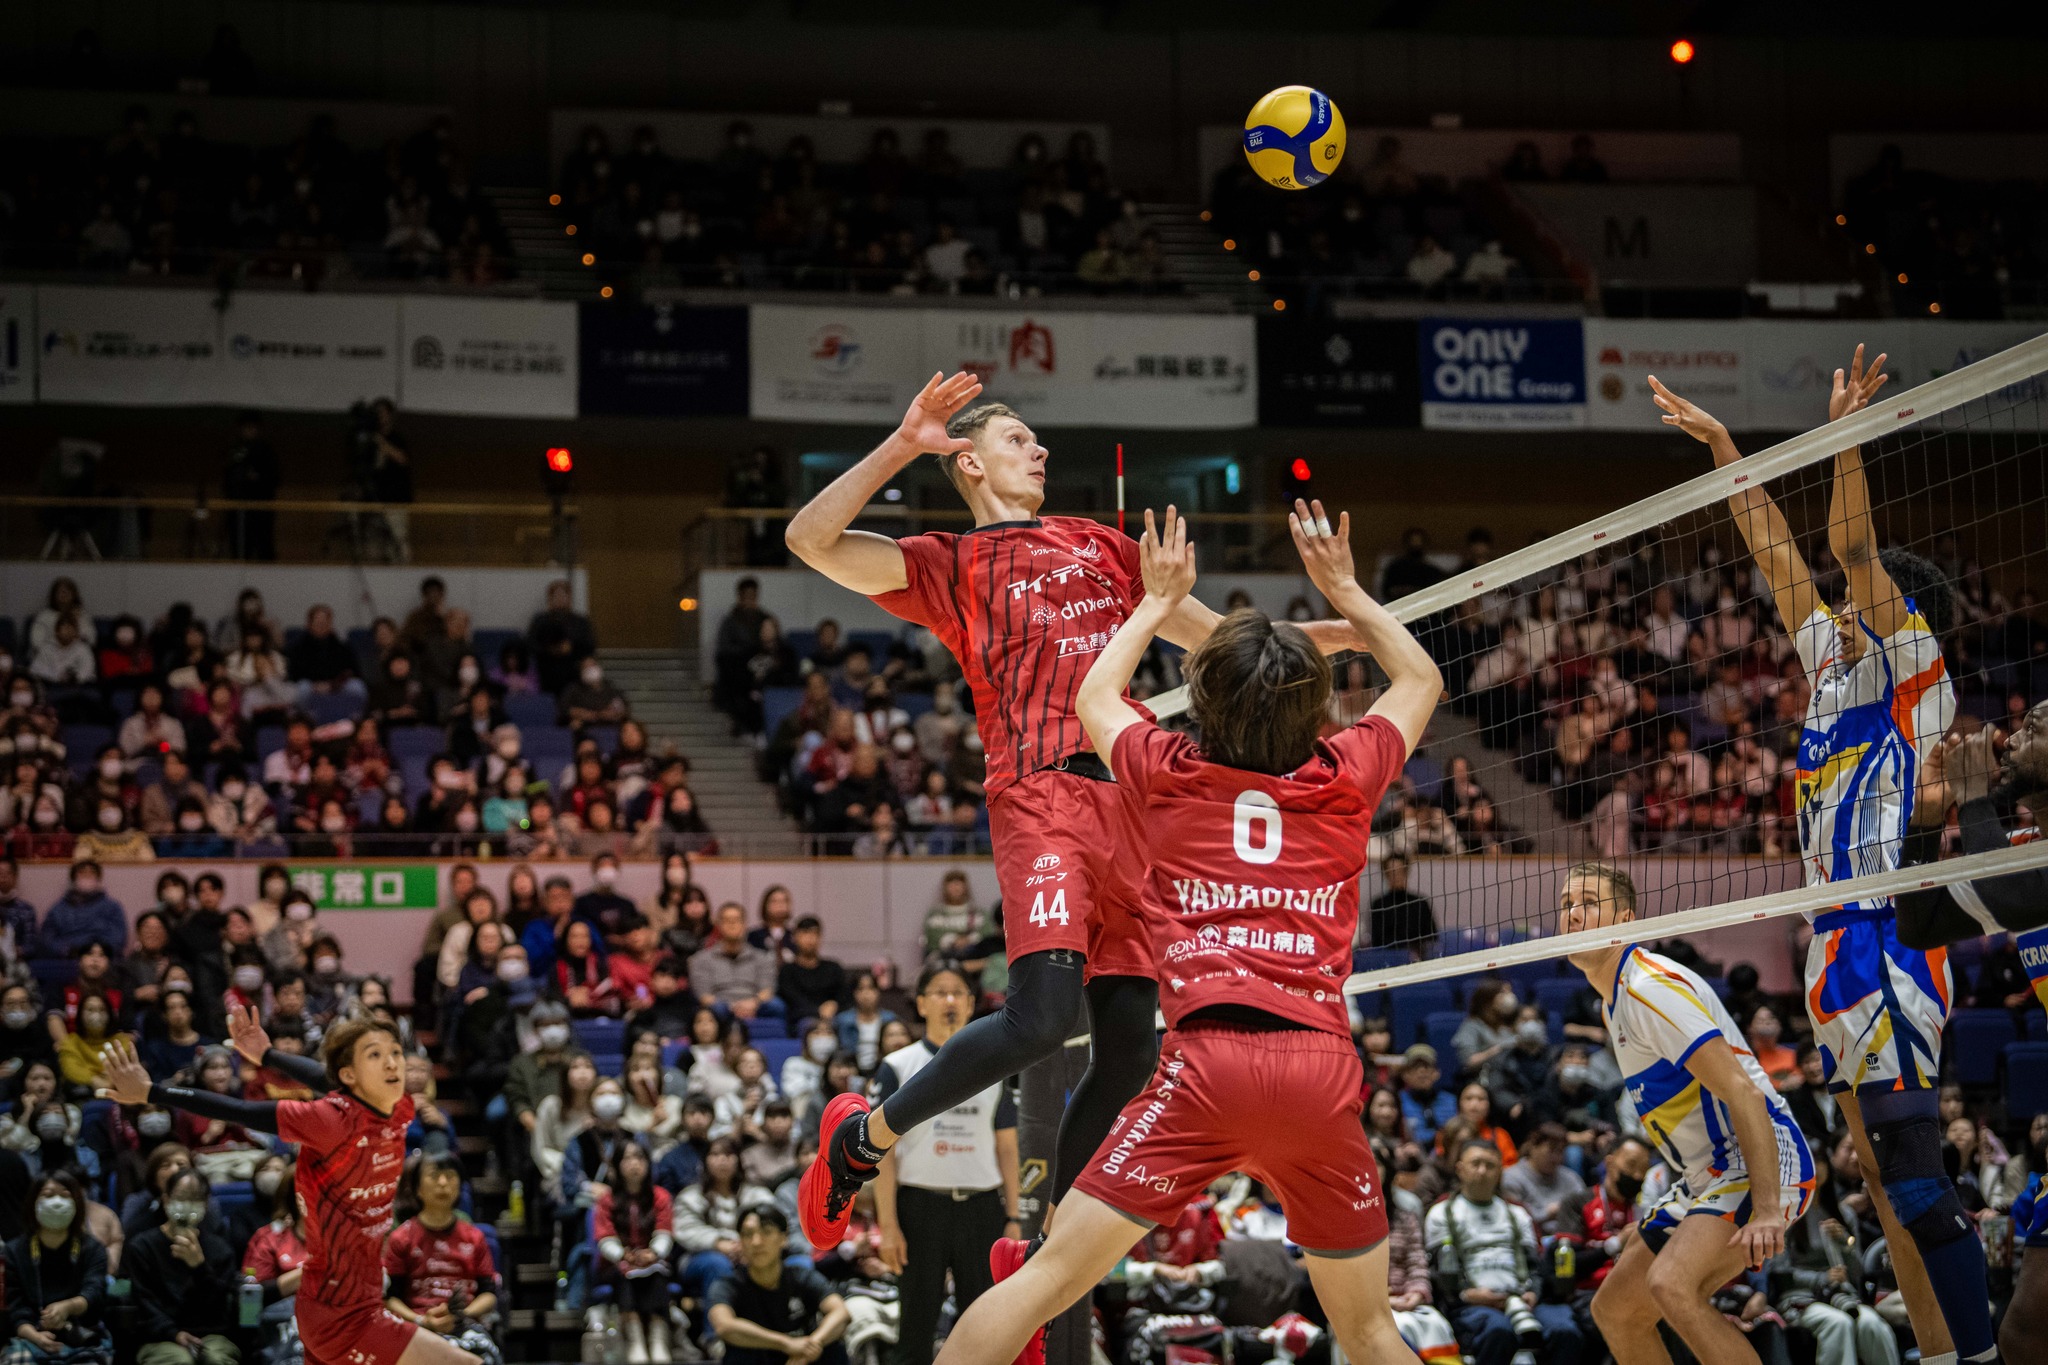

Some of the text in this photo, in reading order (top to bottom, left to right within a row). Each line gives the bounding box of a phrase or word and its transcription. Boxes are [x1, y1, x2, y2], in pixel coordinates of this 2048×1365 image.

[1605, 217, 1651, 259] M
[1034, 855, 1061, 870] ATP
[1025, 872, 1068, 887] グループ
[1029, 888, 1070, 928] 44
[1227, 925, 1316, 956] 森山病院
[1102, 1101, 1166, 1175] HOKKAIDO
[1125, 1164, 1179, 1195] Arai
